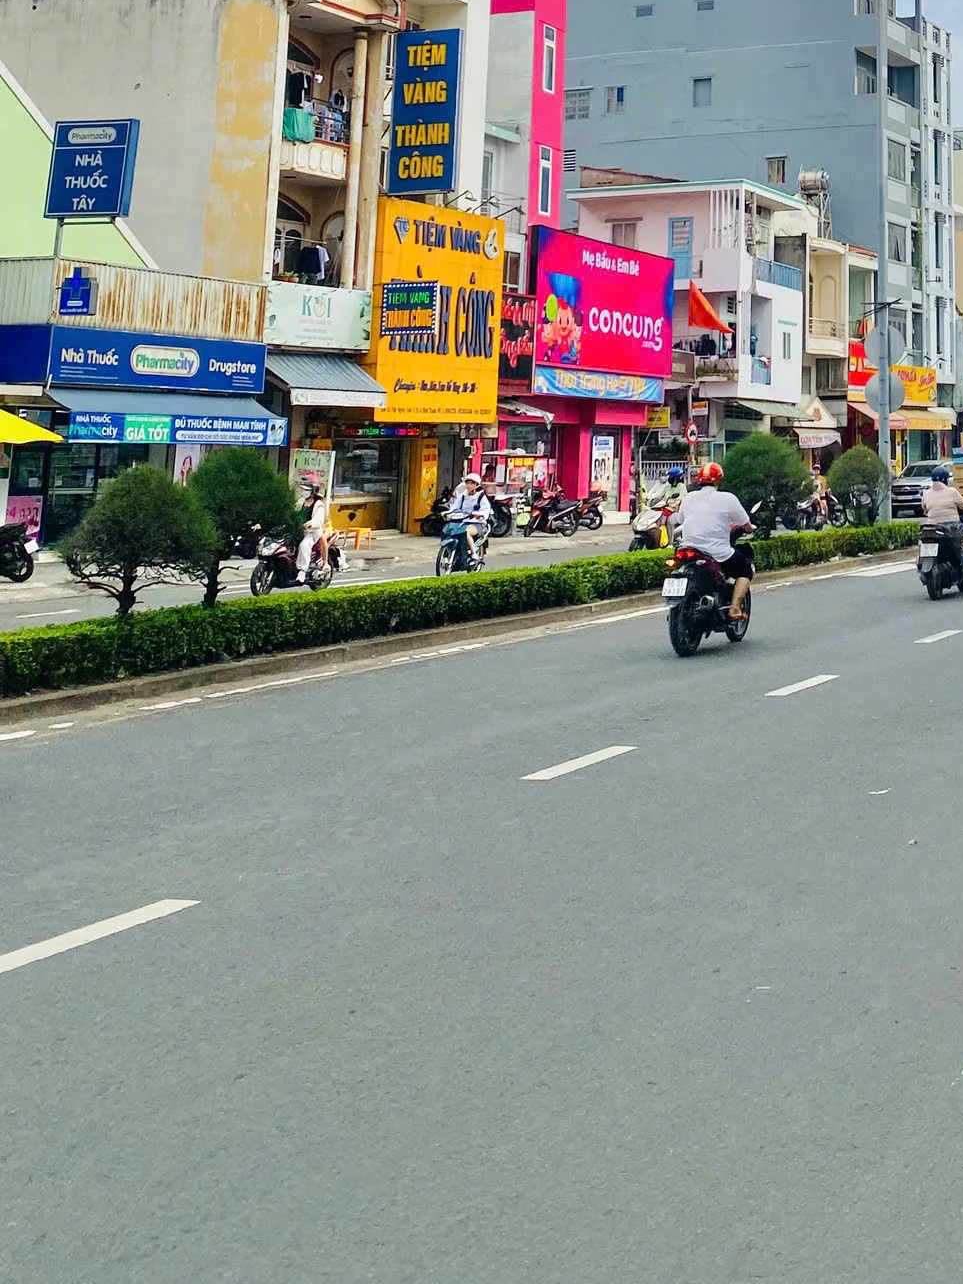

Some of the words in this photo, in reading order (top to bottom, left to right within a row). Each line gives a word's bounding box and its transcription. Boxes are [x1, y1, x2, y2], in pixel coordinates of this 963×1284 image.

[407, 39, 447, 71] TIỆM
[403, 77, 447, 105] VÀNG
[71, 129, 113, 141] Pharmacity
[395, 118, 450, 147] THÀNH
[75, 150, 103, 166] NHÀ
[398, 150, 444, 179] CÔNG
[64, 169, 109, 188] THUỐC
[72, 194, 96, 210] TÂY
[413, 216, 447, 252] TIỆM
[449, 220, 482, 255] VÀNG
[582, 249, 595, 268] Mẹ
[611, 259, 617, 271] &
[617, 257, 629, 274] Em
[629, 259, 640, 276] Bé
[455, 272, 495, 358] CÔNG
[588, 306, 663, 352] concung
[61, 348, 84, 364] Nhà
[87, 348, 119, 366] Thuốc
[136, 351, 195, 373] Pharmacity
[208, 358, 257, 376] Drugstore
[68, 424, 119, 439] Pharmacity
[76, 414, 90, 423] NHÀ
[90, 413, 112, 424] THUỐC
[125, 425, 145, 441] GIÁ
[149, 423, 170, 441] TỐT
[174, 416, 187, 428] ĐỦ
[187, 417, 212, 429] THUỐC
[213, 419, 232, 432] BỆNH
[250, 420, 266, 431] TÍNH
